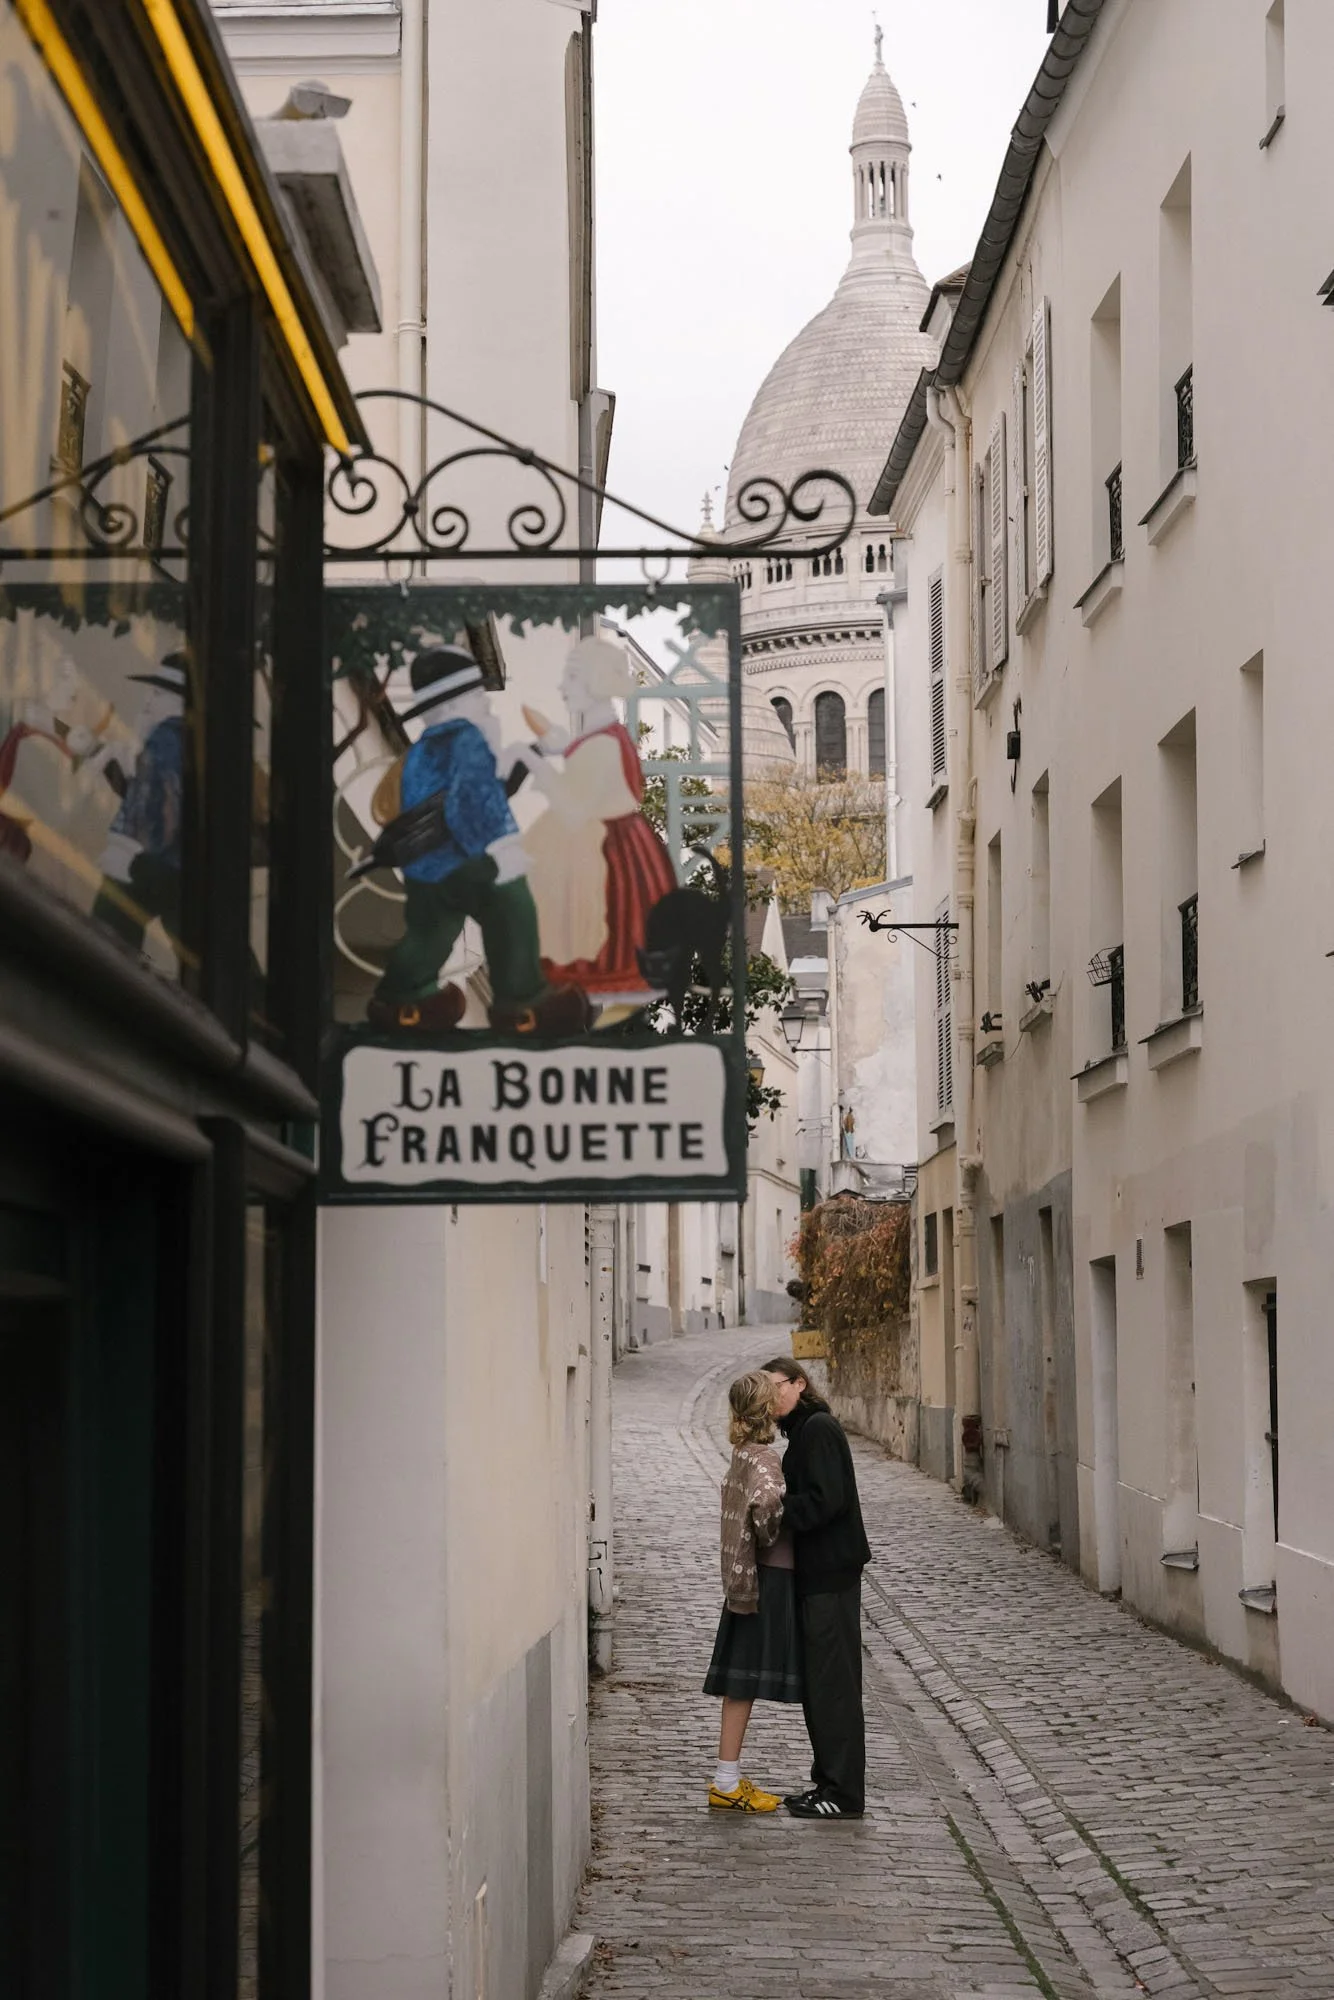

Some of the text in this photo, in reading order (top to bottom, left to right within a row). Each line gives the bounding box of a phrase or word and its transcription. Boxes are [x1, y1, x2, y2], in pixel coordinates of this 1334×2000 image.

[394, 1060, 669, 1112] LA BONNE
[357, 1112, 705, 1169] FRANQUETTE
